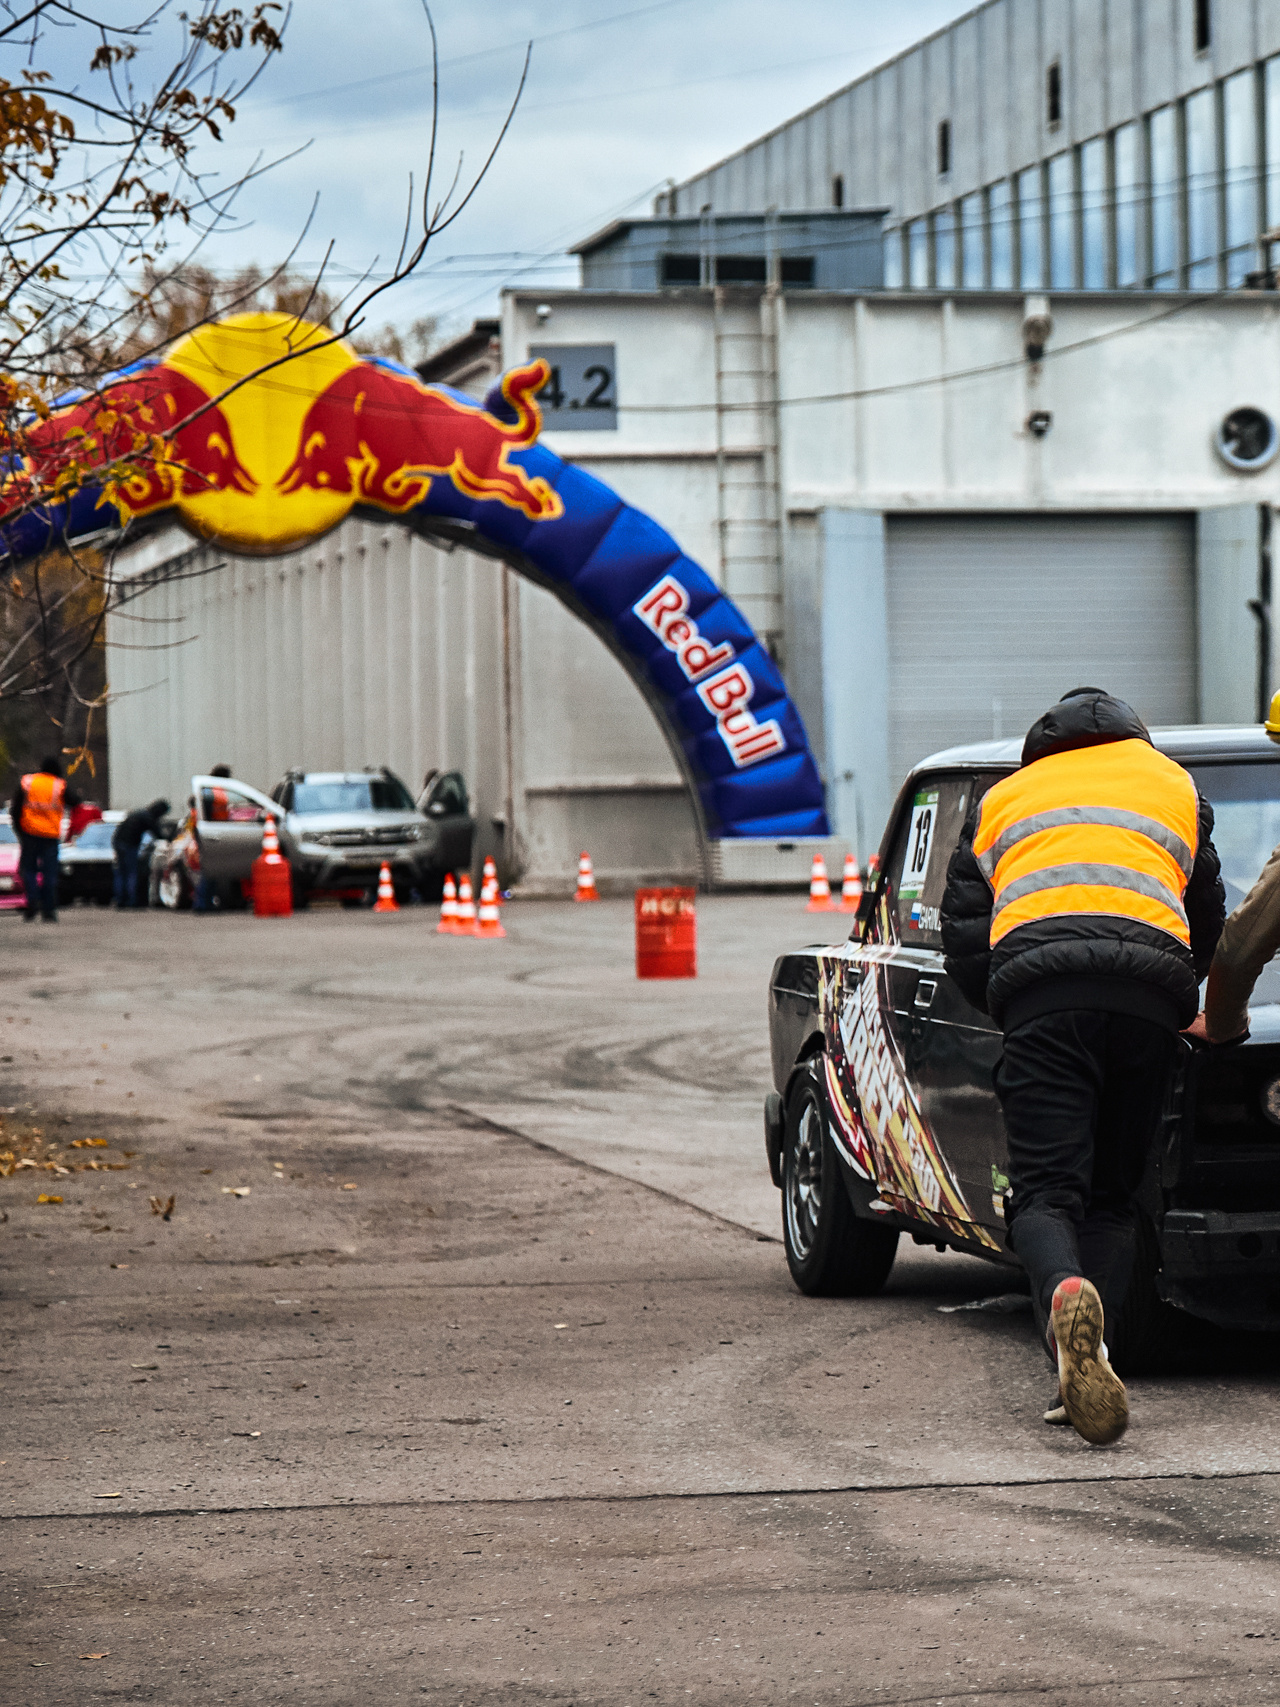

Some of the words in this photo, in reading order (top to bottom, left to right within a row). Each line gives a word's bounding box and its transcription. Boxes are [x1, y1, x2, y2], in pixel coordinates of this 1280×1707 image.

[535, 365, 612, 411] 4.2
[632, 575, 736, 682] Red
[696, 662, 786, 768] Bull
[911, 809, 932, 874] 13
